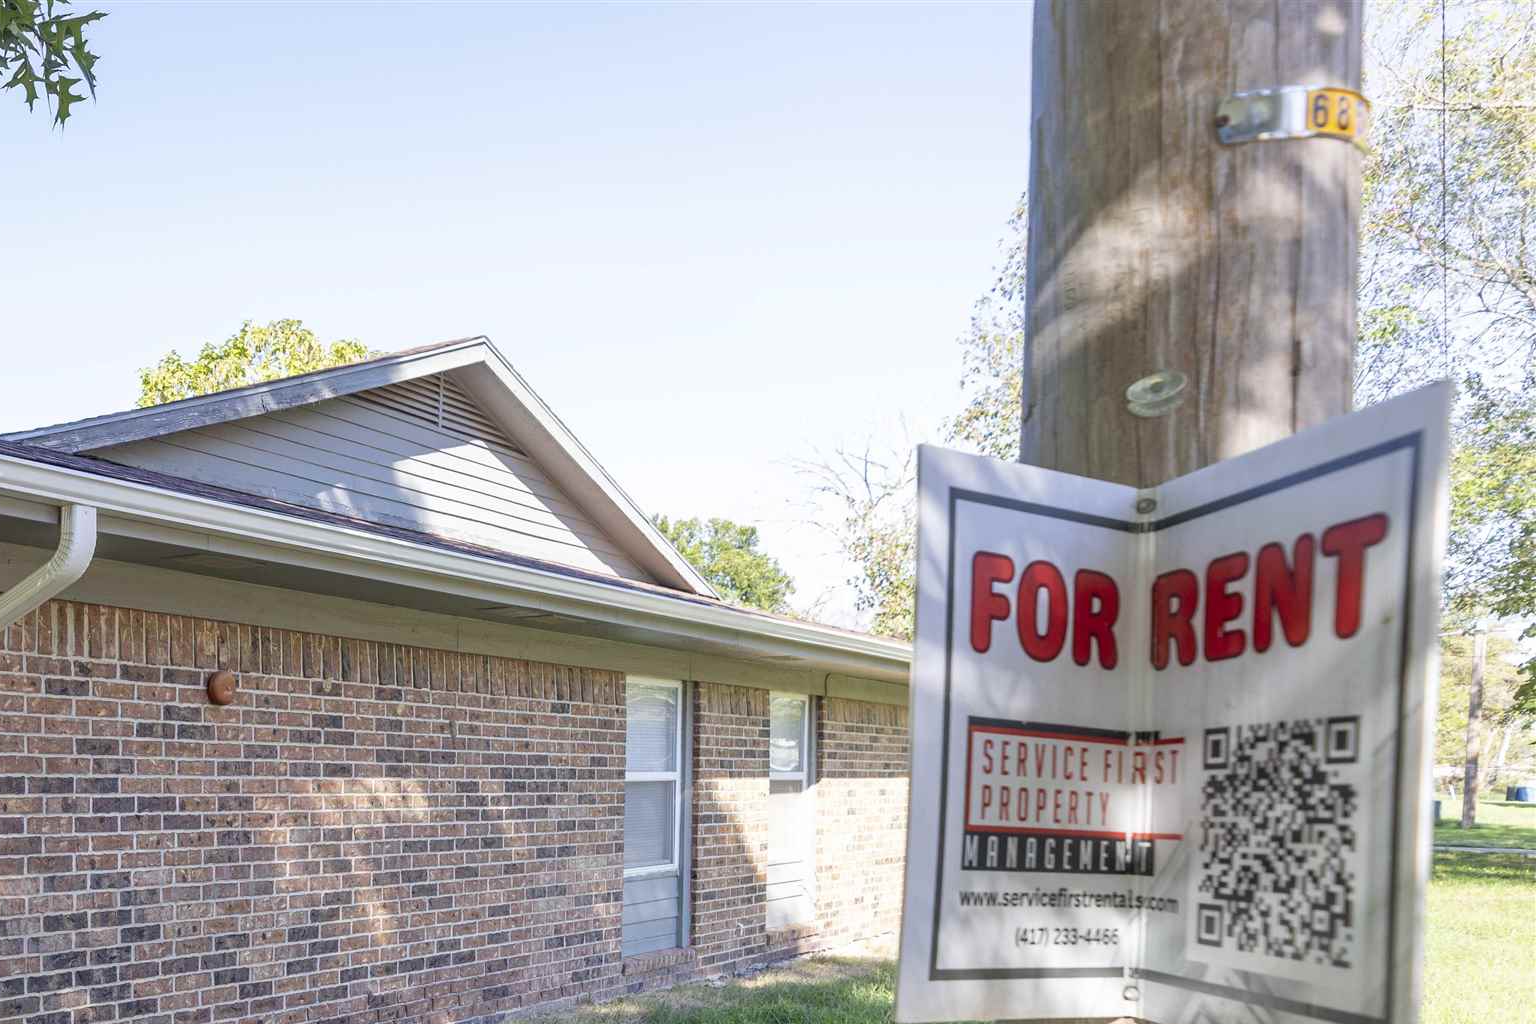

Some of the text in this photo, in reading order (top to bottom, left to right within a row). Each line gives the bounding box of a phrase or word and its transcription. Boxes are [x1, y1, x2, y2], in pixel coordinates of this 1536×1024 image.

[970, 512, 1389, 671] FOR RENT
[982, 739, 1179, 784] SERVICE FIRST
[981, 784, 1110, 826] PROPERTY
[964, 834, 1152, 872] MANAGEMENT
[1015, 927, 1048, 947] (417)
